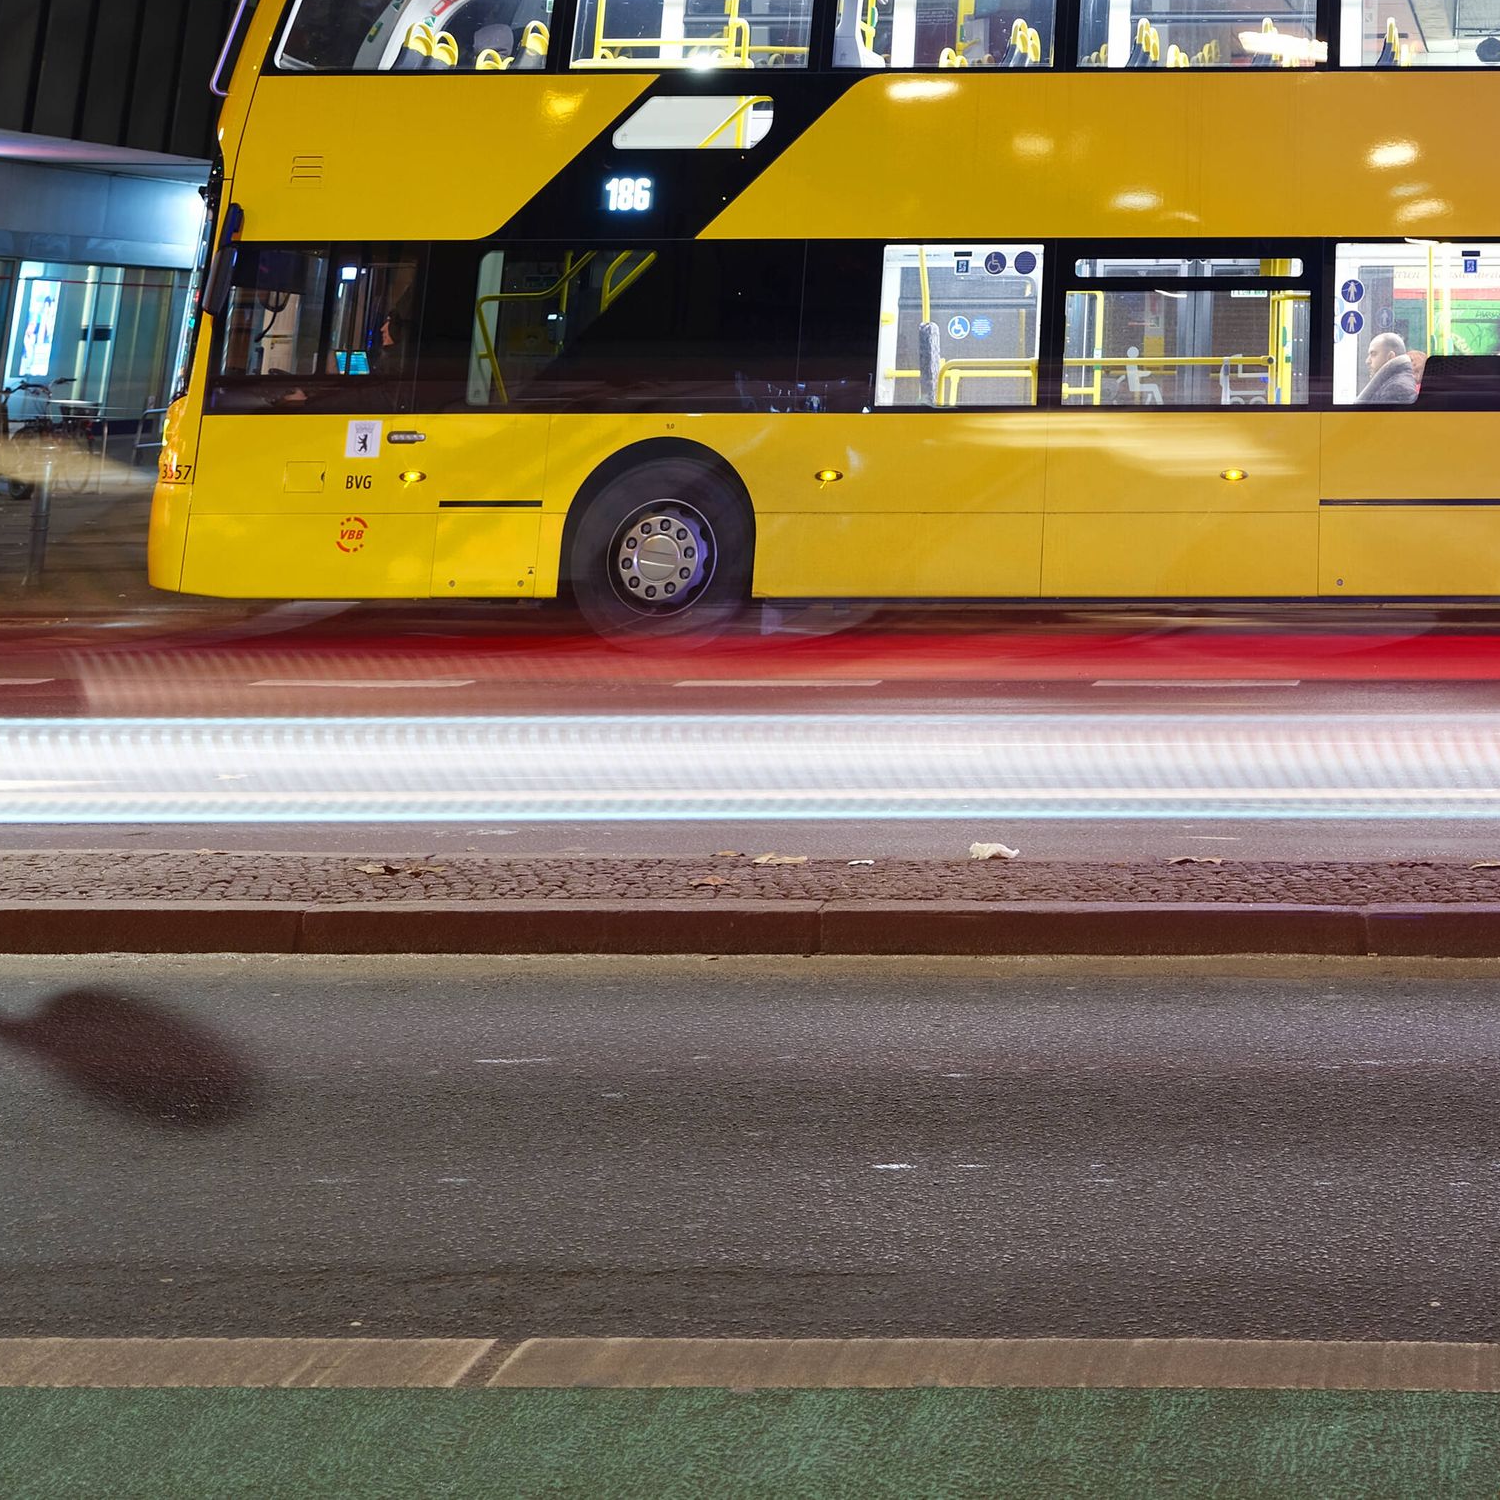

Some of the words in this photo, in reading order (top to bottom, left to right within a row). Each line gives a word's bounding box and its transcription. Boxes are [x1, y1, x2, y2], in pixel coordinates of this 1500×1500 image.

[605, 177, 652, 211] 186
[161, 465, 192, 480] 3557
[345, 475, 372, 490] BVG
[339, 529, 364, 541] VBB
